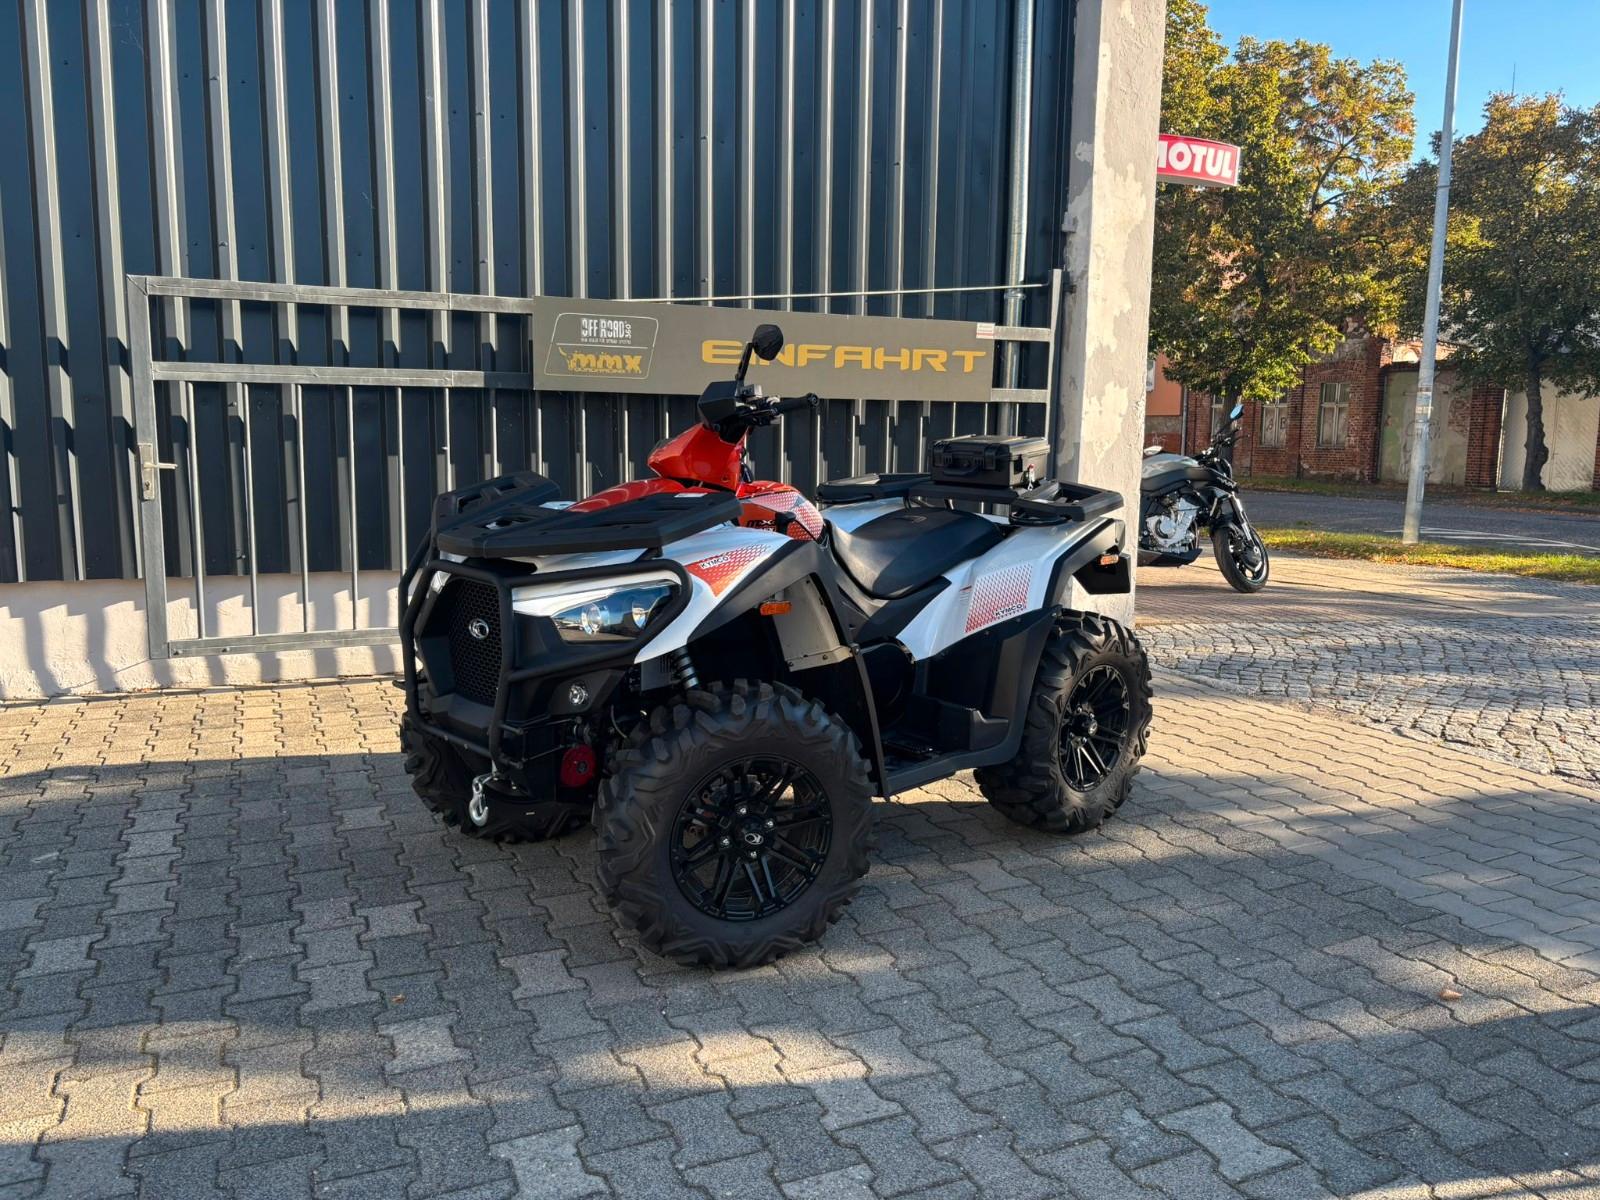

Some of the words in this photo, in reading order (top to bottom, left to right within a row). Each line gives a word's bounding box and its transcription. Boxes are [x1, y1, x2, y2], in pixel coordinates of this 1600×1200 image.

[581, 318, 599, 337] OFF
[600, 319, 625, 338] ROAD
[700, 555, 729, 569] KYMCO
[995, 603, 1023, 616] KYMCO
